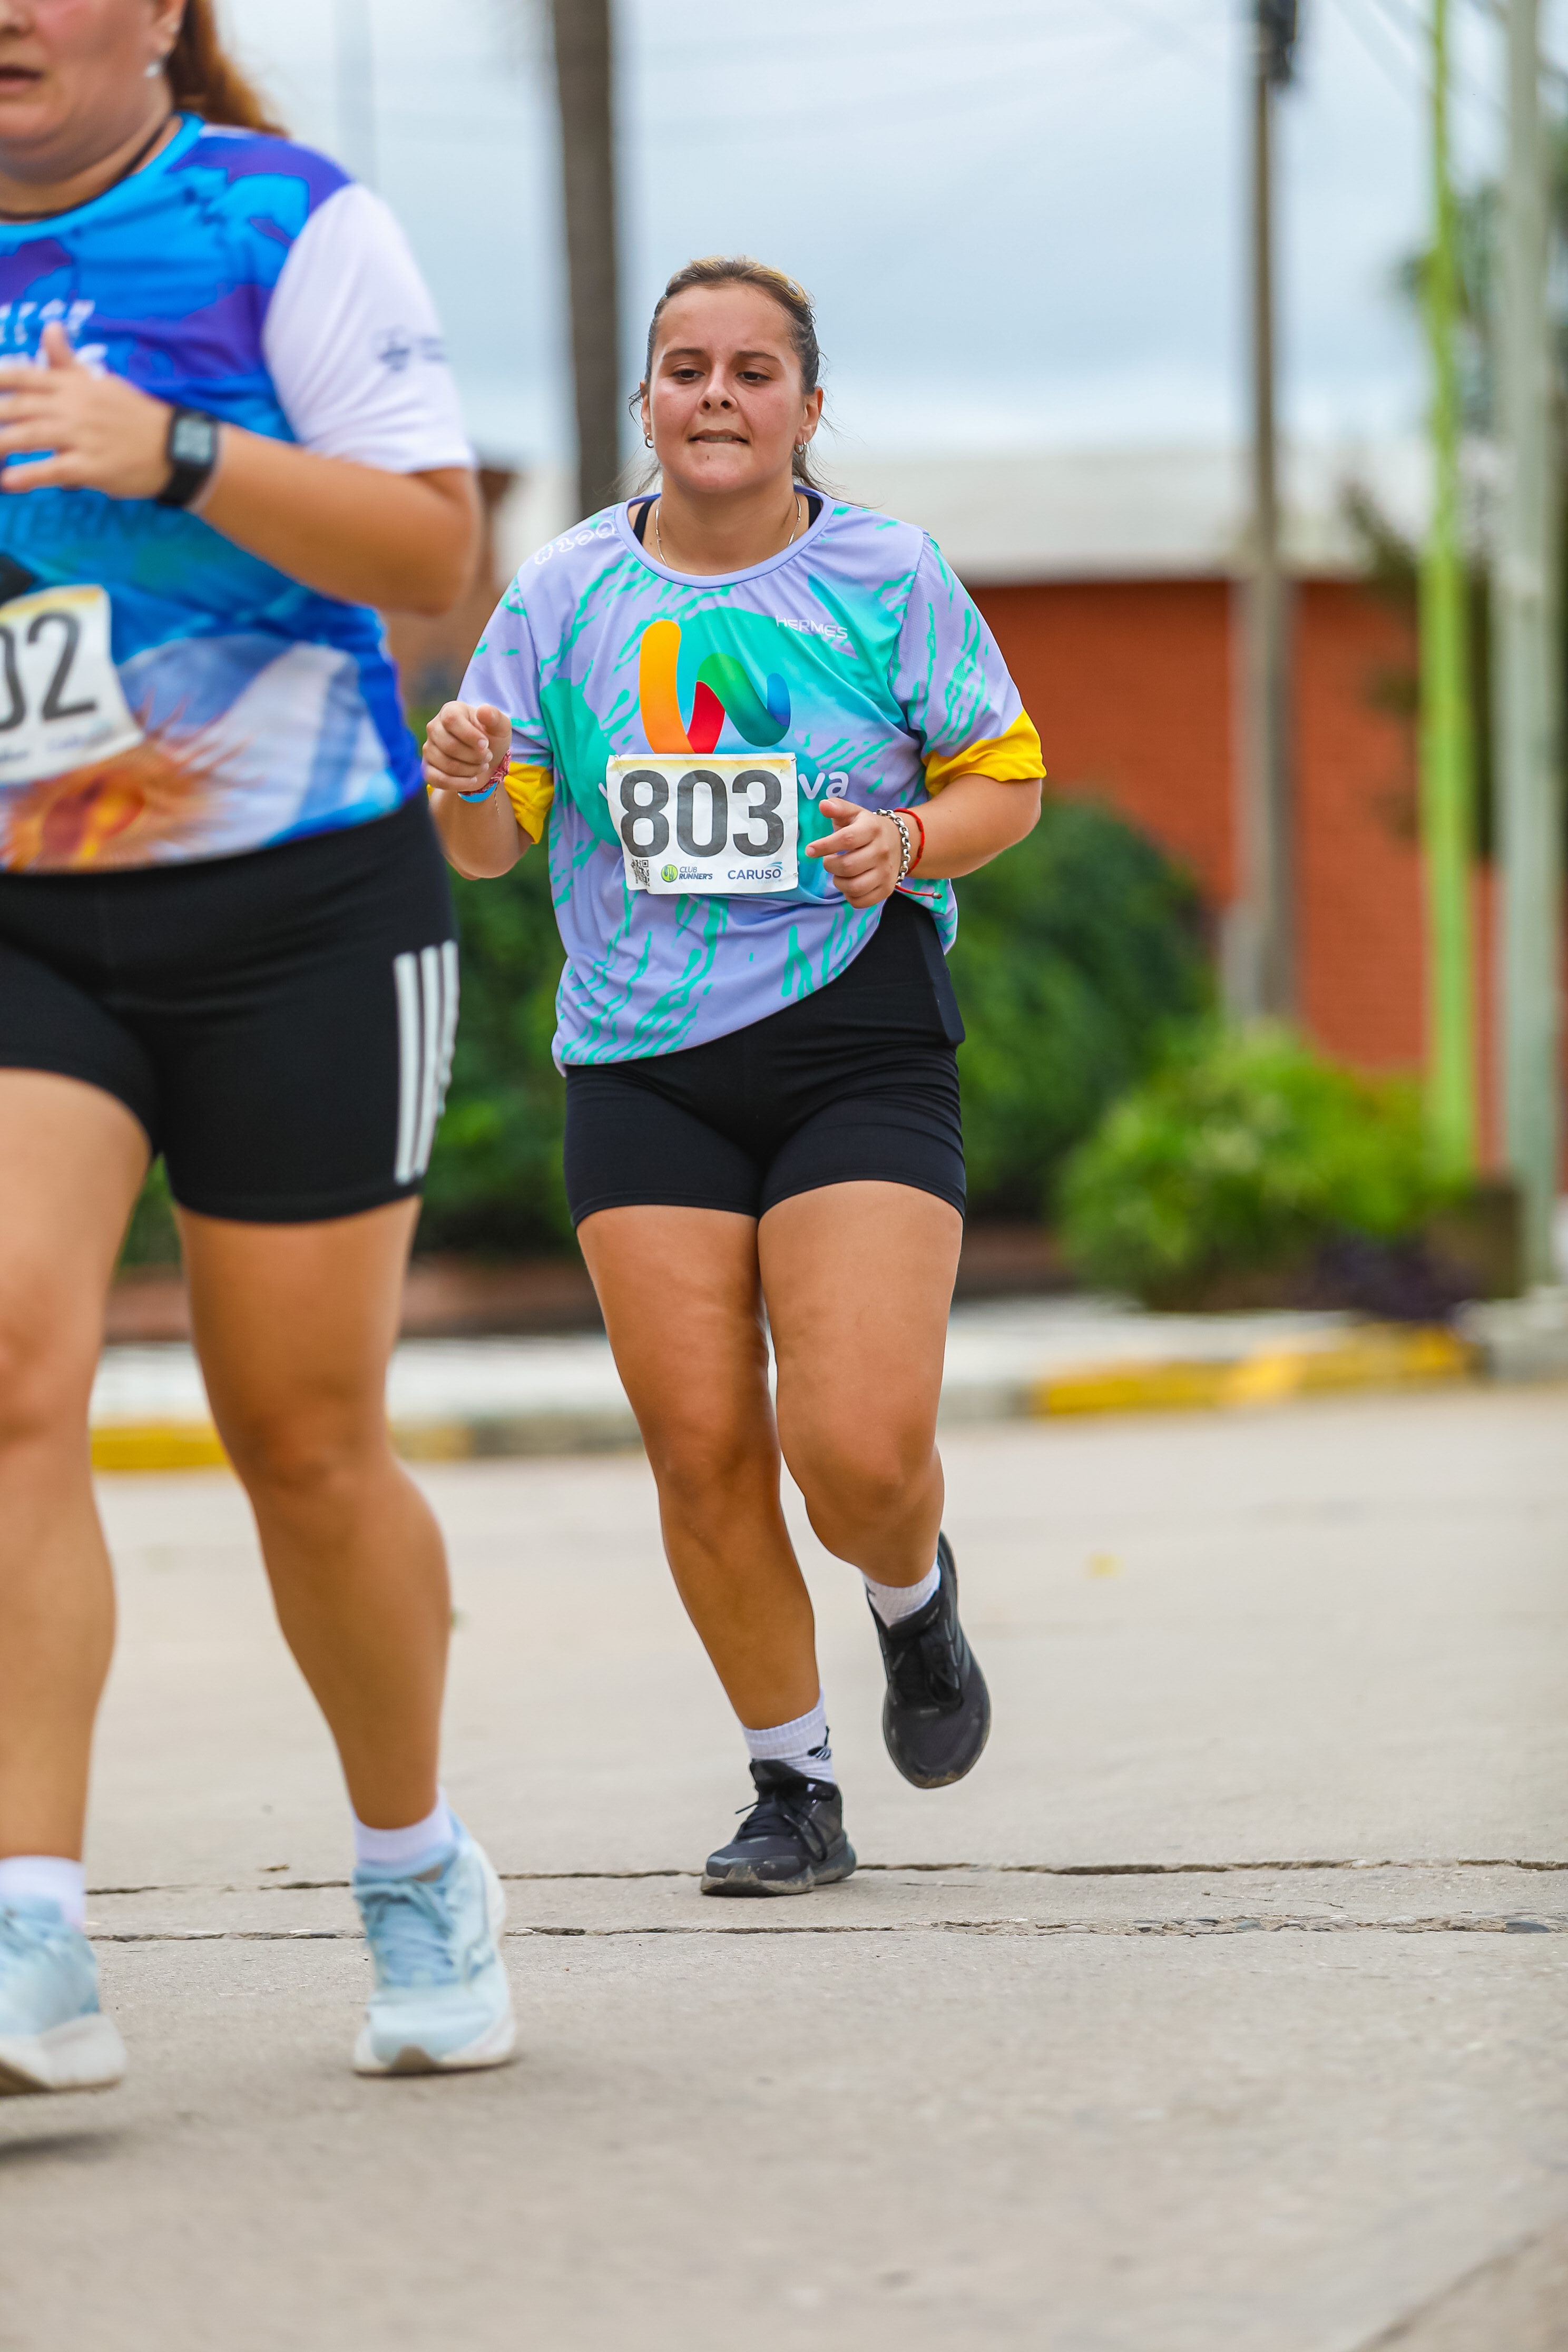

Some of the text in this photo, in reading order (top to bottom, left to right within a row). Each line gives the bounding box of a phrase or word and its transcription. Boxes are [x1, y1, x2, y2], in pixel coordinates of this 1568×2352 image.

[775, 615, 848, 640] HERMES
[798, 771, 849, 800] va
[620, 769, 784, 858] 803
[727, 868, 781, 880] CARUSO
